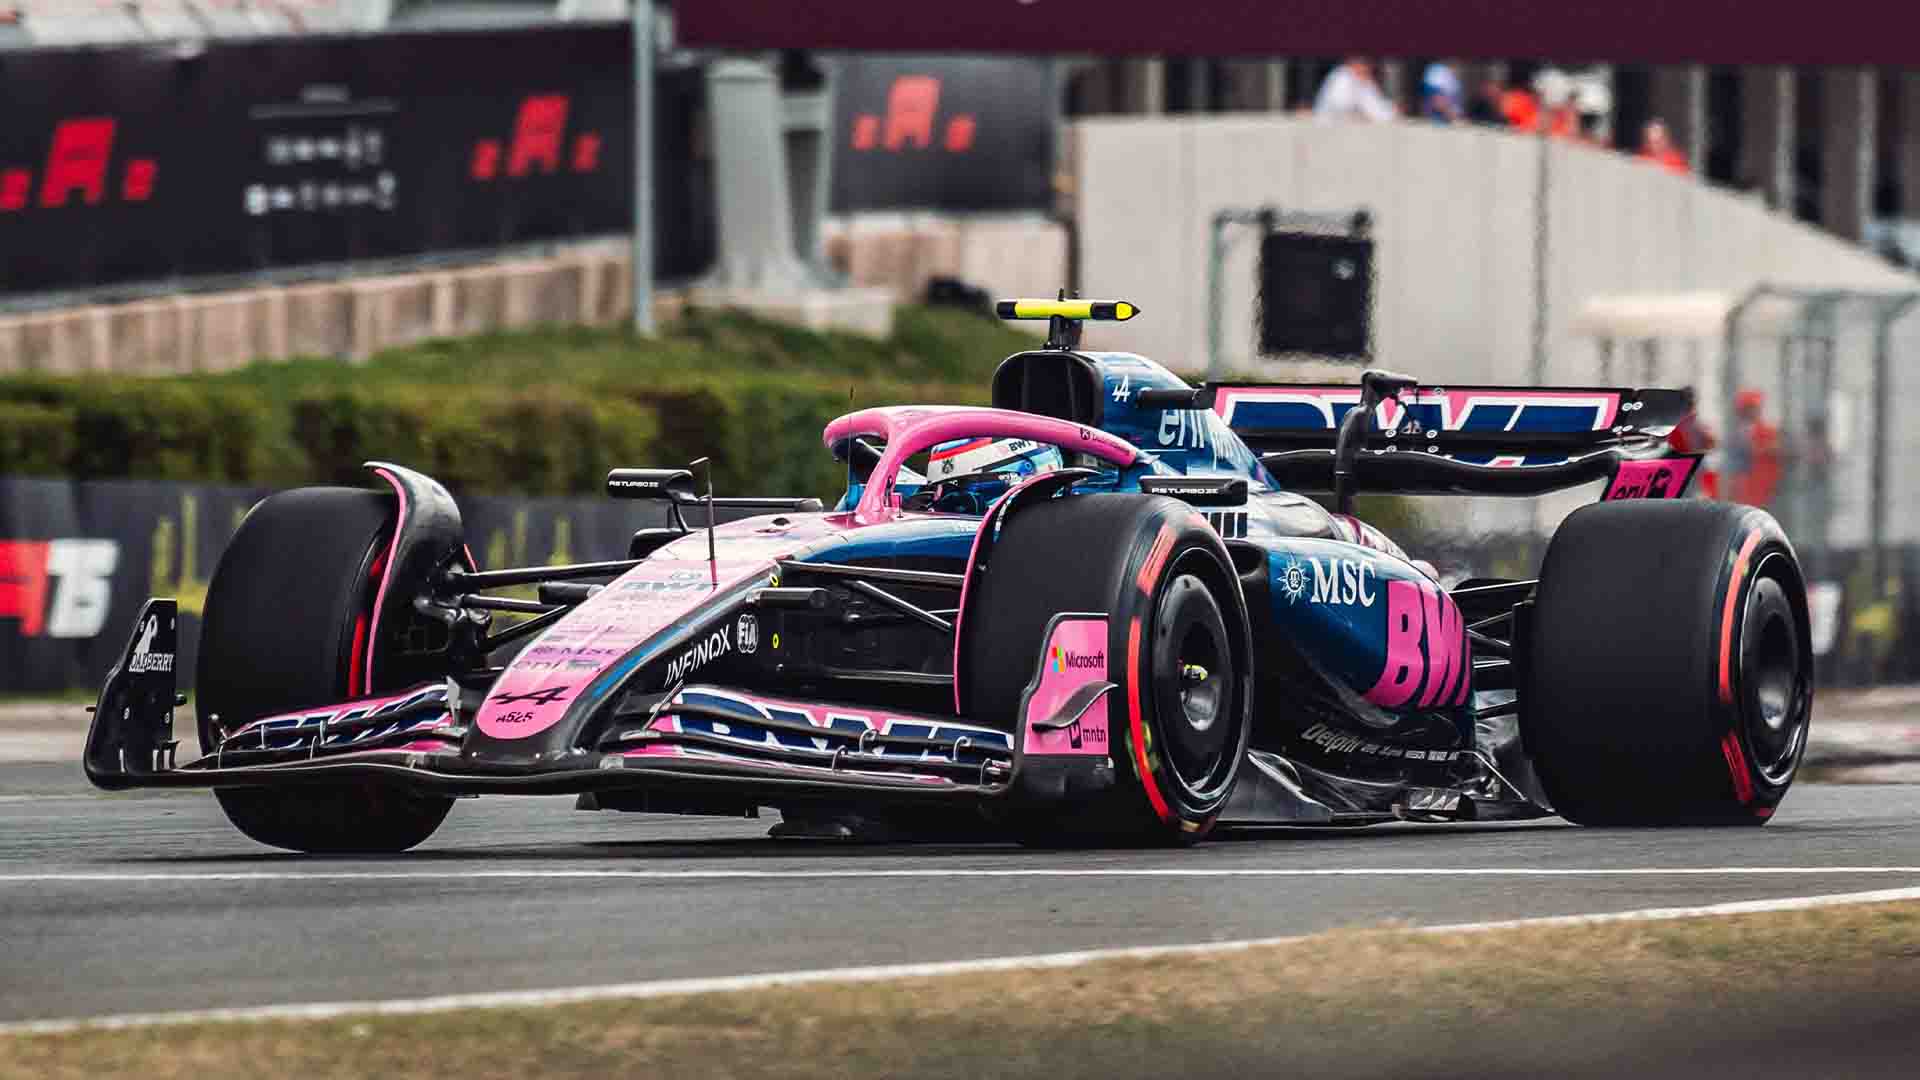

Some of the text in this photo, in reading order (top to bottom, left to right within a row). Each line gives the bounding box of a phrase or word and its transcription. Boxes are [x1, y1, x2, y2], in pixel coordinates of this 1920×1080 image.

[1309, 558, 1375, 608] MSC
[664, 625, 732, 687] INFINOX
[1066, 652, 1104, 669] Microsoft
[1083, 726, 1106, 743] mntn
